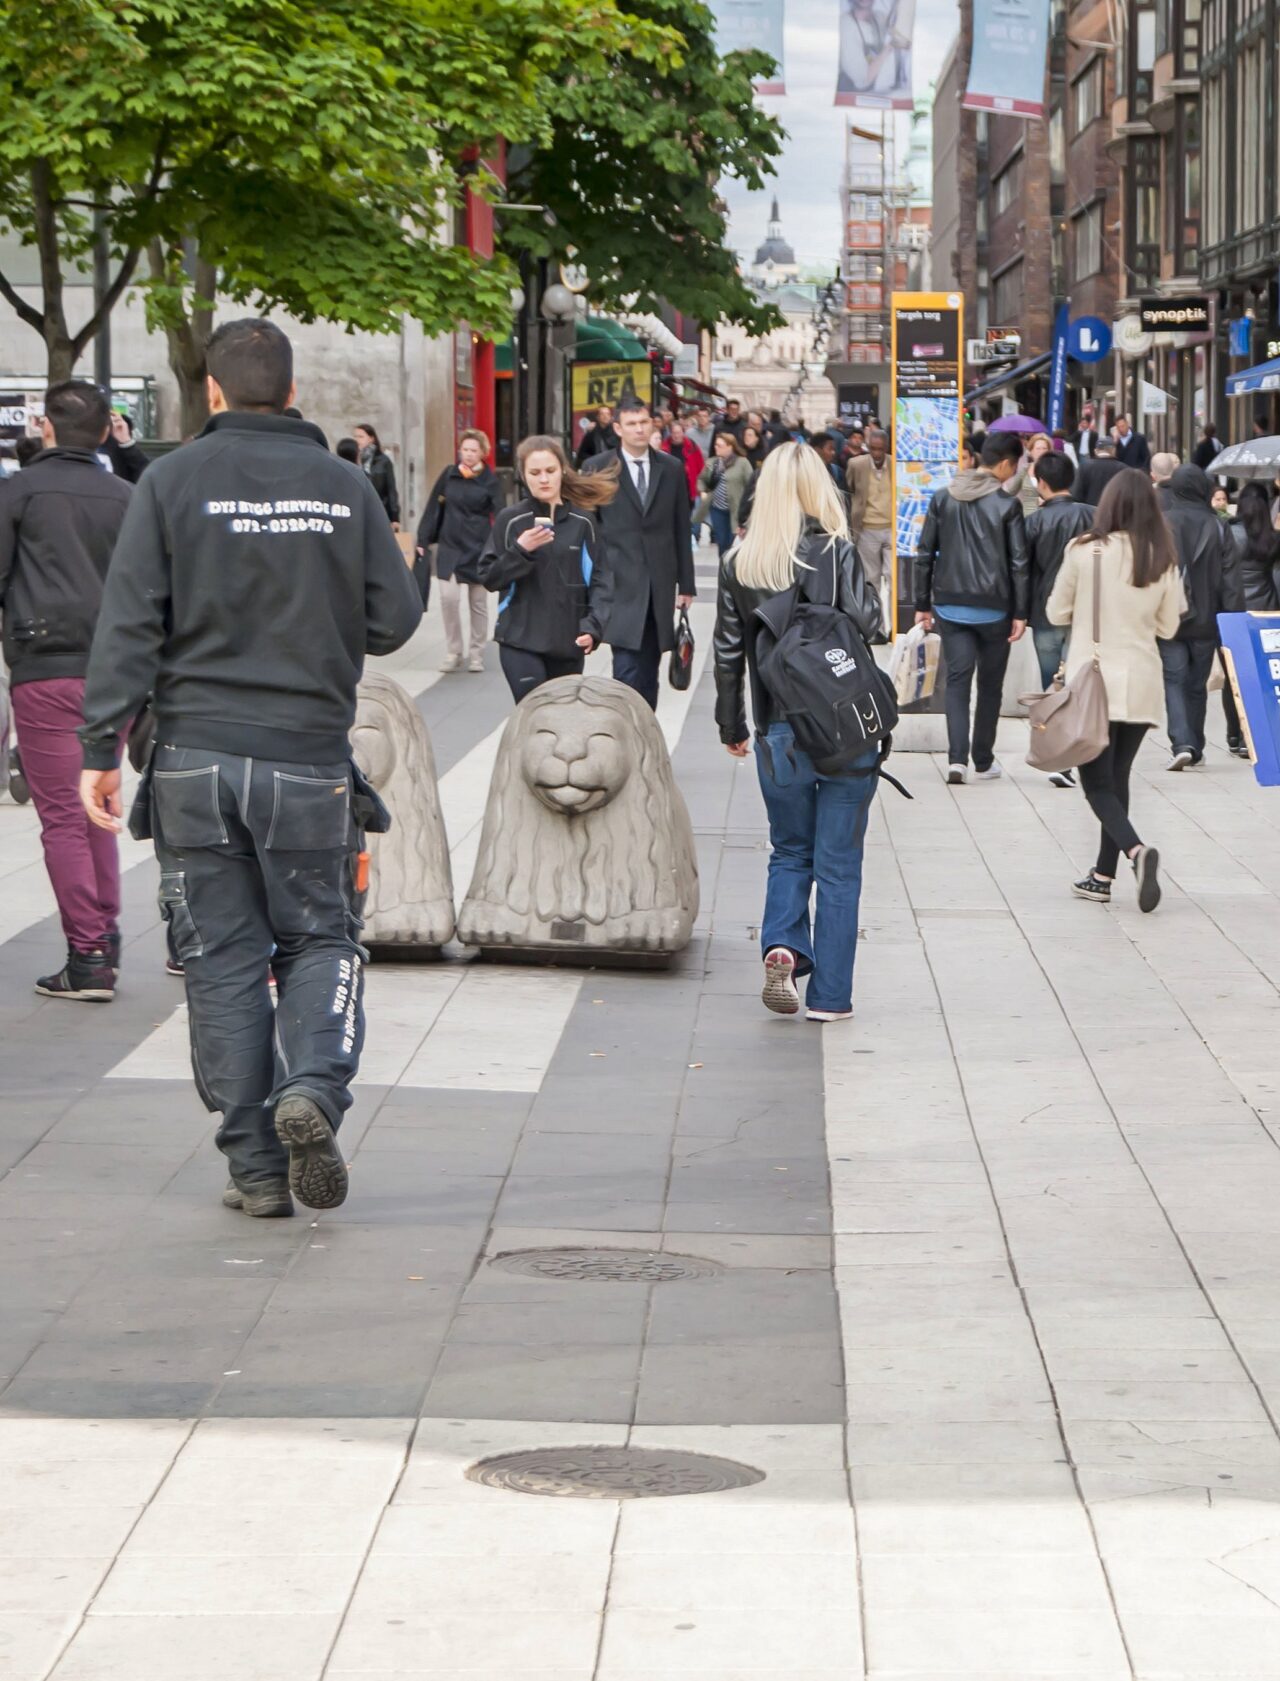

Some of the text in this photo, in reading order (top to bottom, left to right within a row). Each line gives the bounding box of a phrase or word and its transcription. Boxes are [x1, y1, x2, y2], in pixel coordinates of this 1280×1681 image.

[1143, 307, 1207, 324] synoptik
[588, 376, 636, 405] REA
[275, 500, 329, 515] SERVICE
